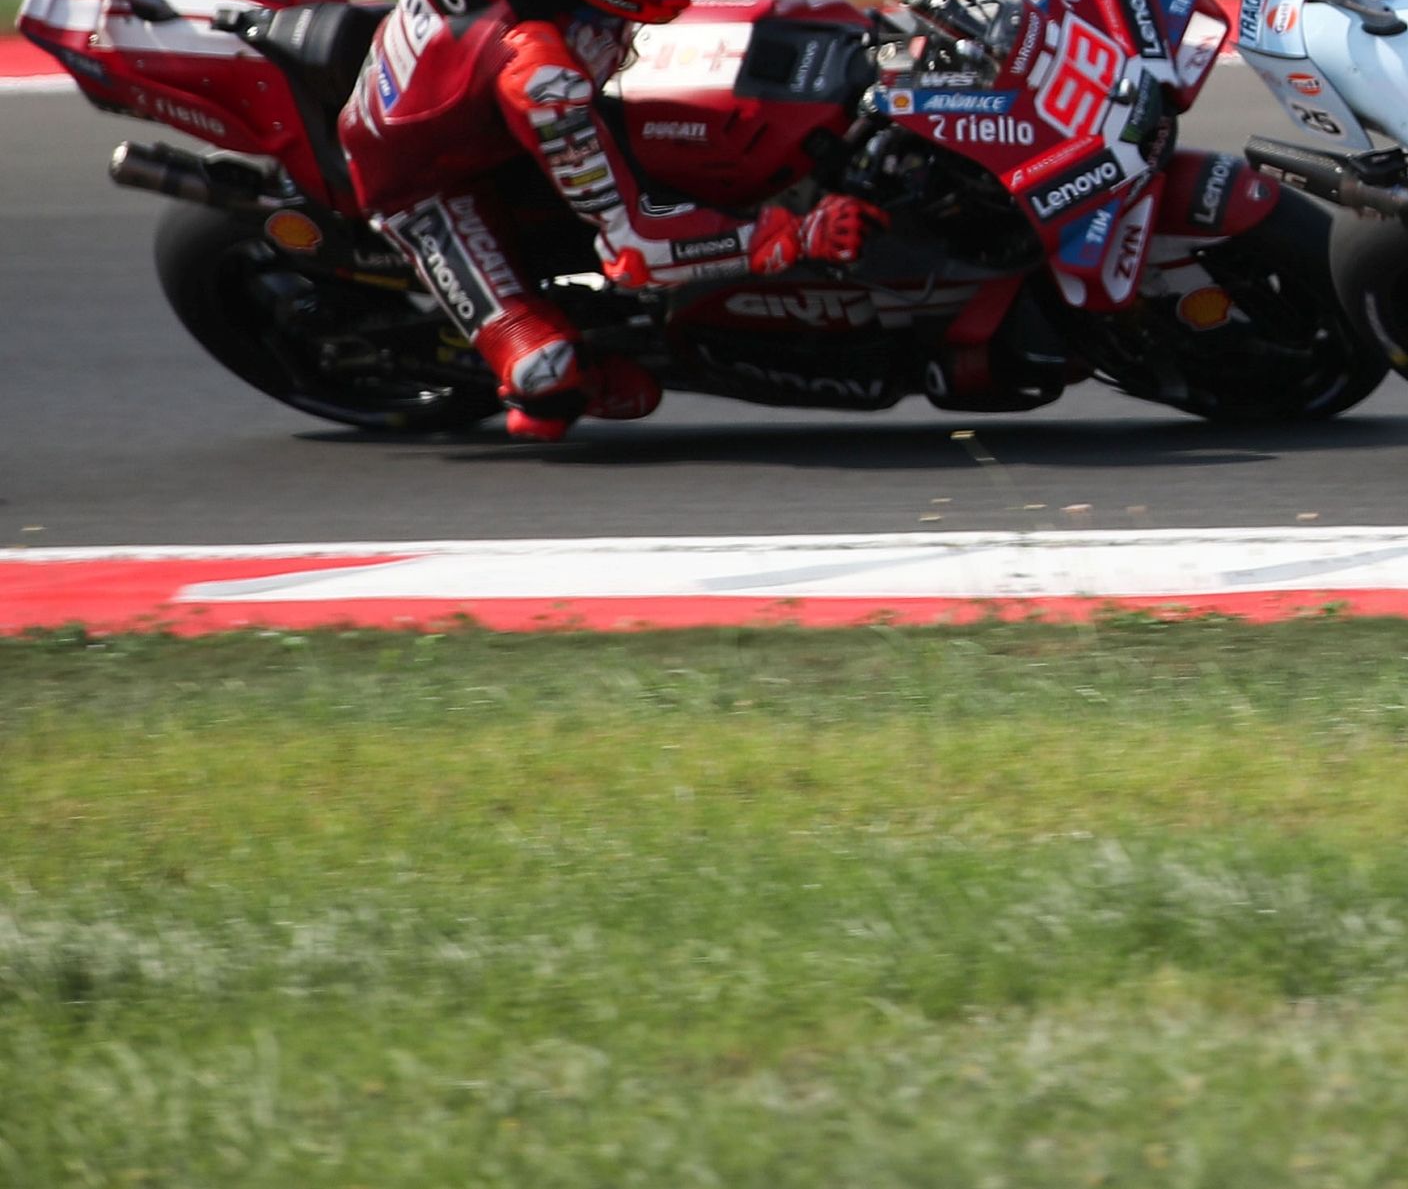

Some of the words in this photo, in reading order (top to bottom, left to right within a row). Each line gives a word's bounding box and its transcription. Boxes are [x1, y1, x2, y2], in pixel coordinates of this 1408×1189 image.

[1043, 21, 1120, 137] 93
[923, 95, 1007, 111] ADVANCE
[642, 121, 708, 140] DUCATI
[955, 113, 1035, 146] riello
[1030, 161, 1118, 217] Lenovo
[1085, 209, 1113, 245] TIM
[449, 195, 523, 300] DUCATI
[675, 236, 737, 259] Lenovo
[410, 214, 475, 321] Lenovo
